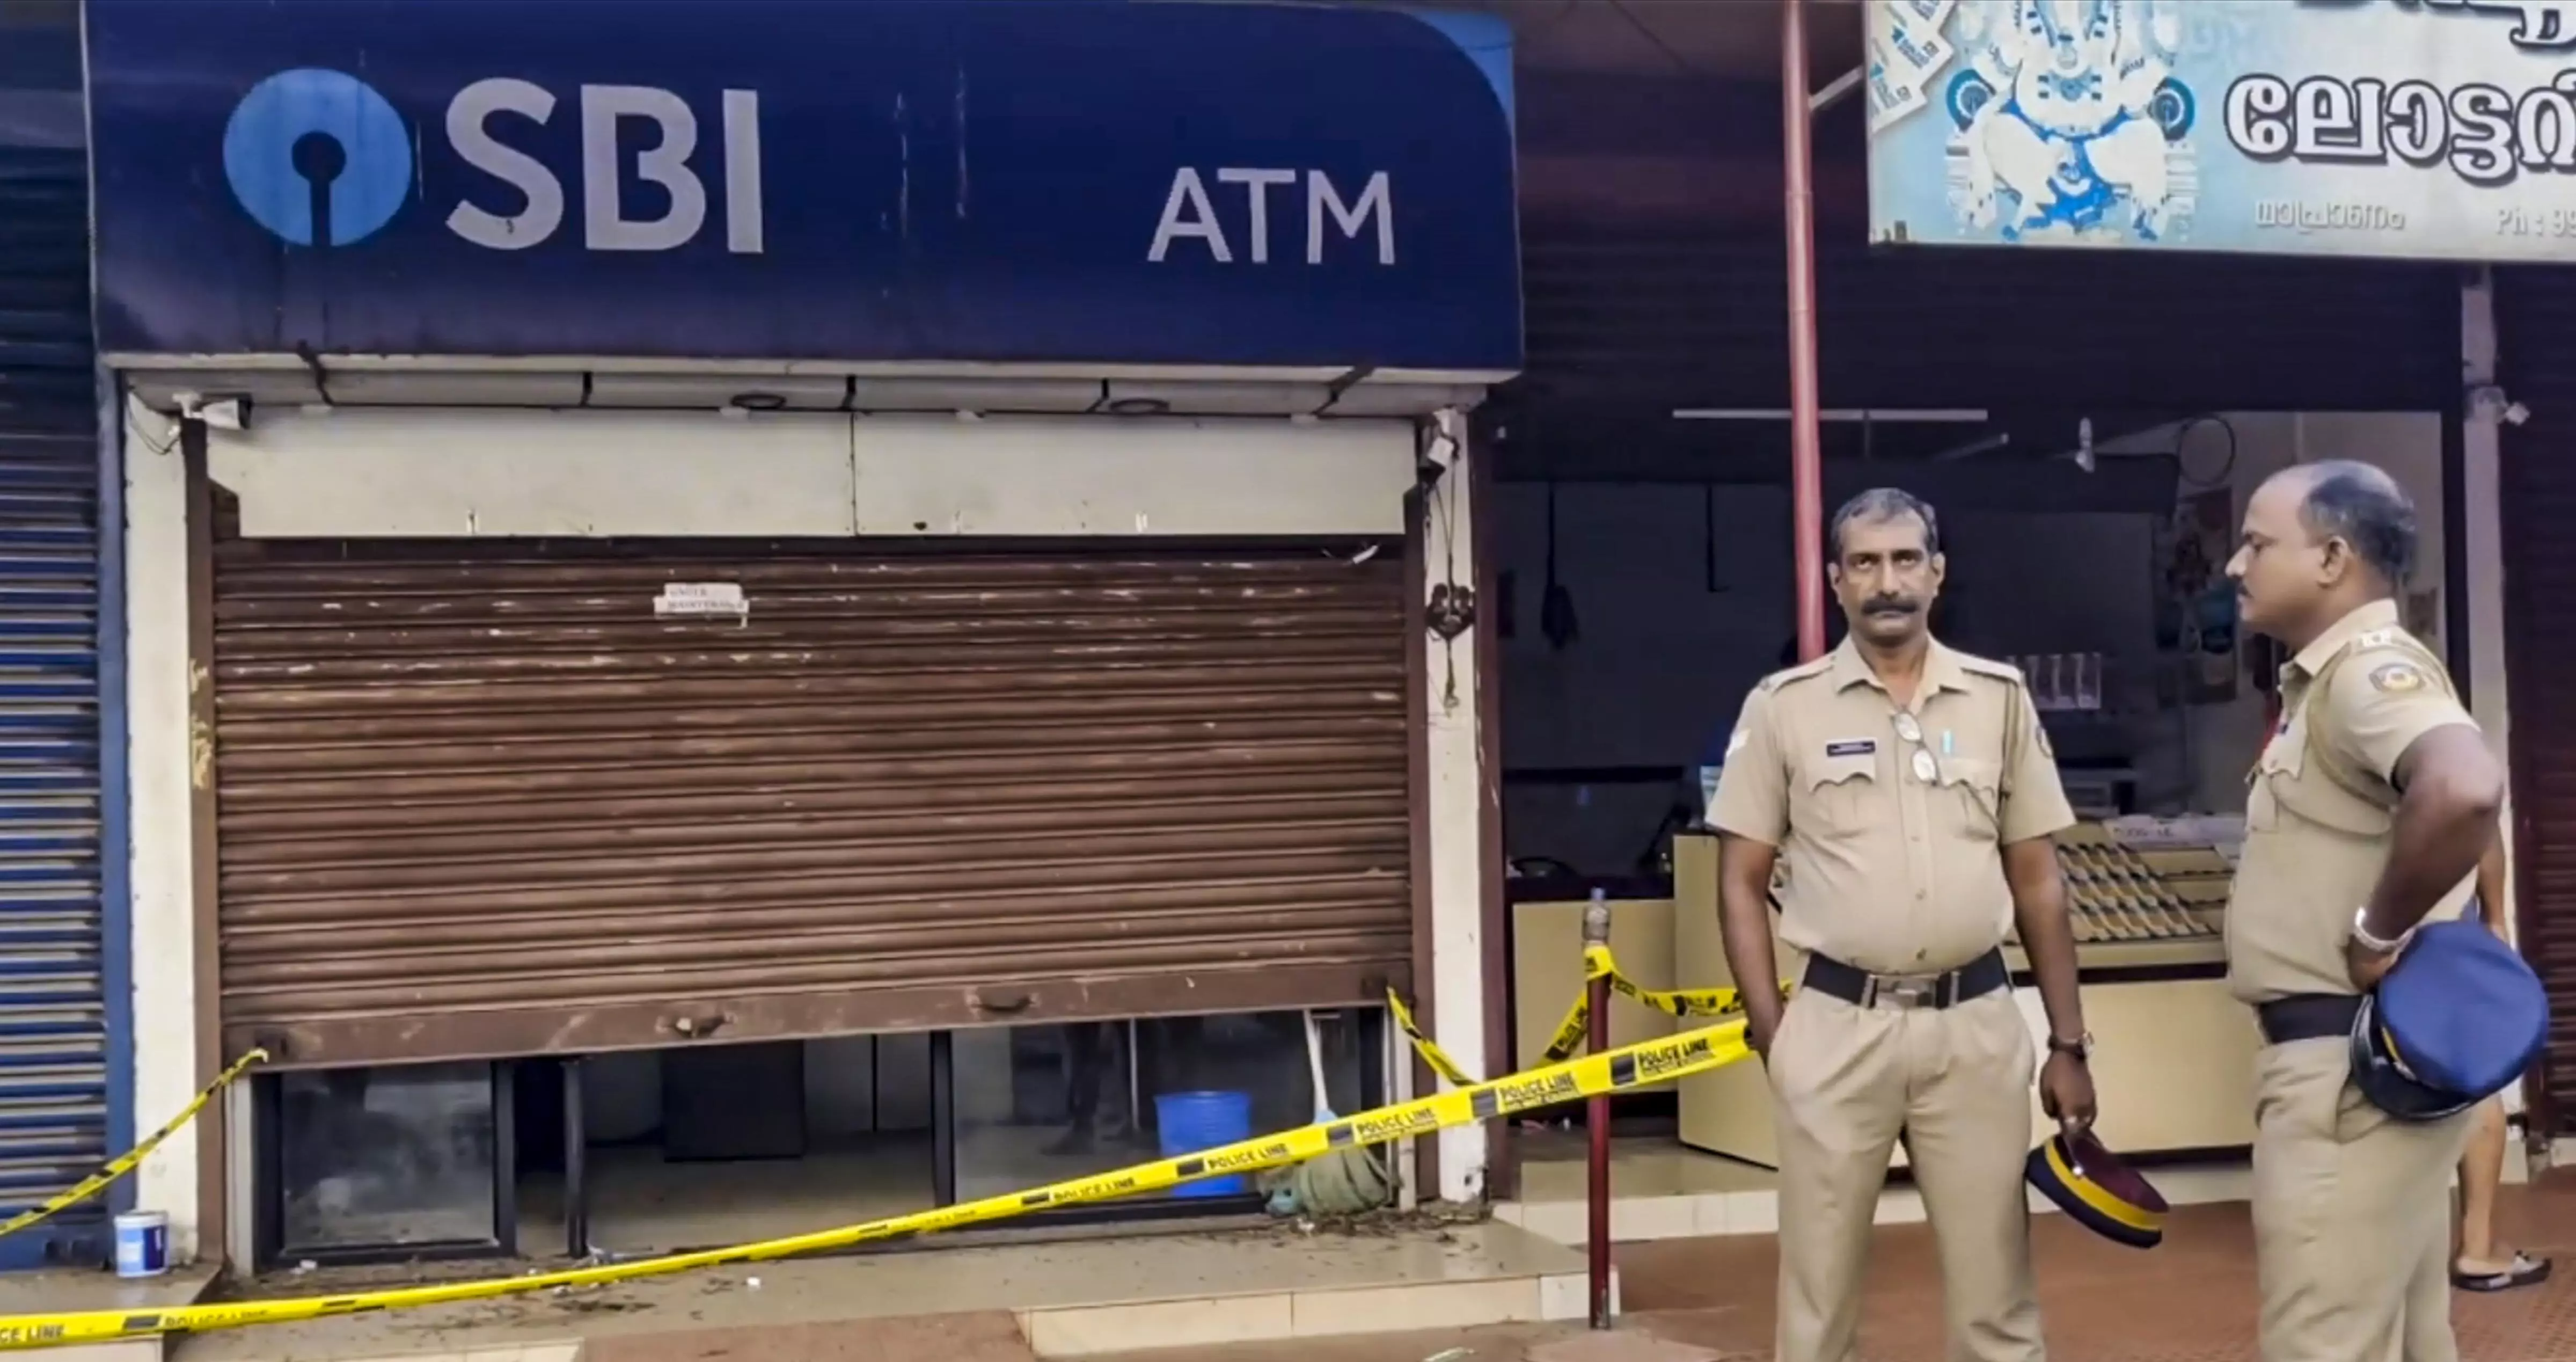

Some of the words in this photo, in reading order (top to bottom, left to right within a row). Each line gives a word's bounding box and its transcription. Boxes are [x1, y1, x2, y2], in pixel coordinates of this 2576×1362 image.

[445, 77, 763, 253] SBI
[1147, 167, 1395, 265] ATM
[2496, 204, 2529, 235] Ph
[1638, 1045, 1680, 1067] POLICE
[1682, 1037, 1709, 1057] LINE
[1499, 1076, 1545, 1101] POLICE
[1546, 1070, 1575, 1090] LINE
[1356, 1115, 1403, 1135] POLICE
[1406, 1106, 1436, 1124] LINE
[1208, 1150, 1255, 1170] POLICE
[1257, 1142, 1288, 1159] LINE
[26, 1323, 66, 1339] LINE
